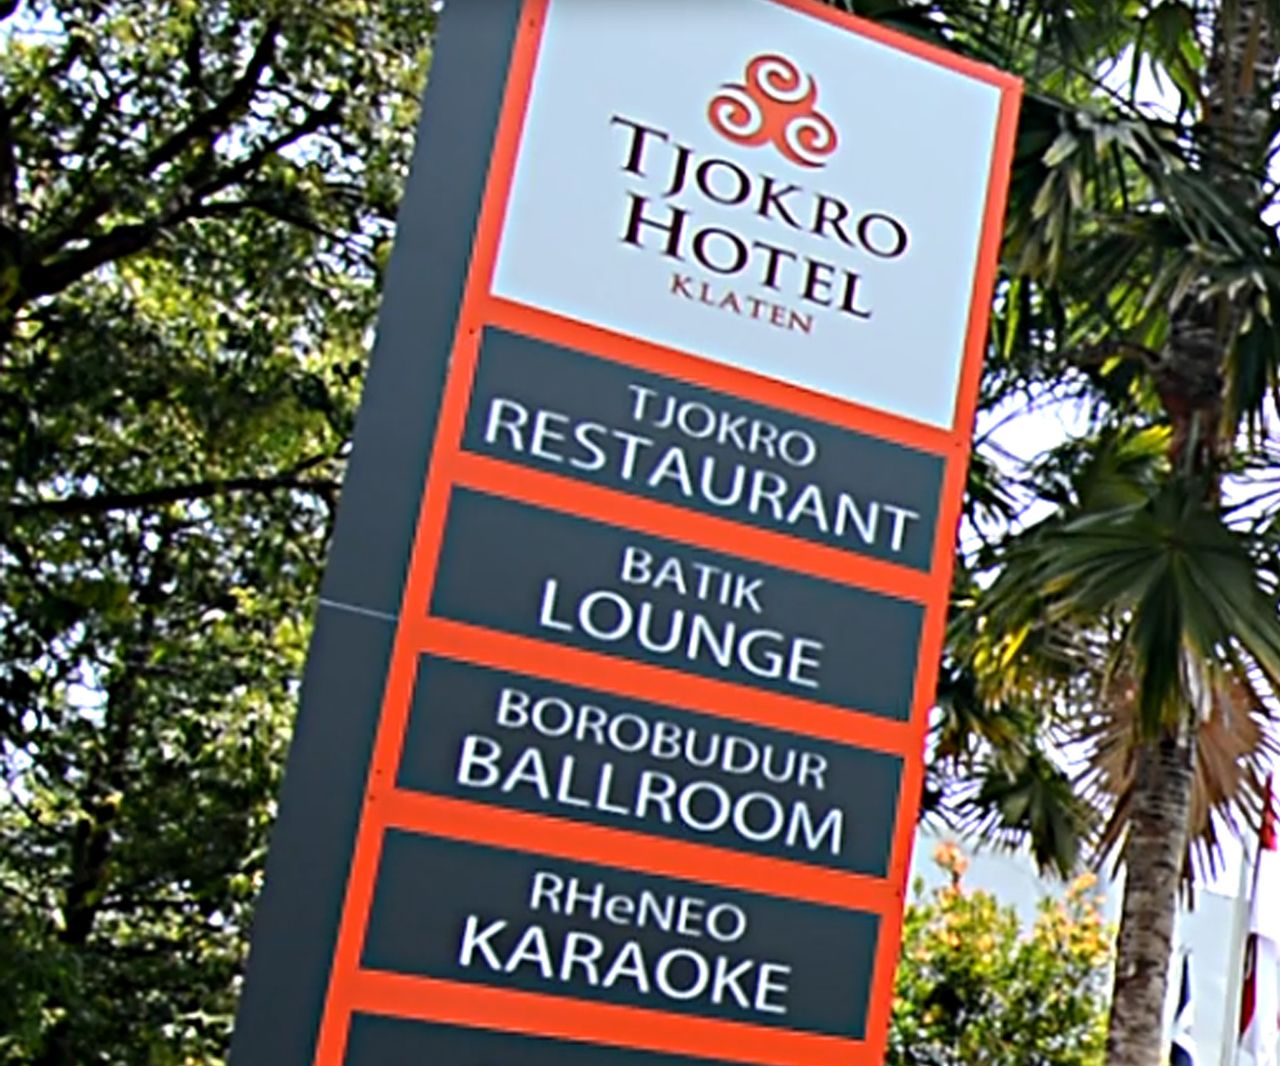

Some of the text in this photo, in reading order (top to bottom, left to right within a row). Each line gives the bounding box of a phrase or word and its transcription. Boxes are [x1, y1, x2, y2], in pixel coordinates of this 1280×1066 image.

[611, 117, 908, 259] TJOKRO
[620, 192, 871, 318] HOTEL
[671, 274, 813, 335] KLATEN
[484, 398, 919, 552] RESTAURANT
[627, 385, 817, 467] TJOKRO
[620, 547, 764, 614] BATIK
[539, 579, 824, 688] LOUNGE
[496, 688, 828, 790] BOROBUDUR
[456, 736, 844, 855] BALLROOM
[530, 872, 747, 941] RHeNEO
[458, 915, 791, 1014] KARAOKE
